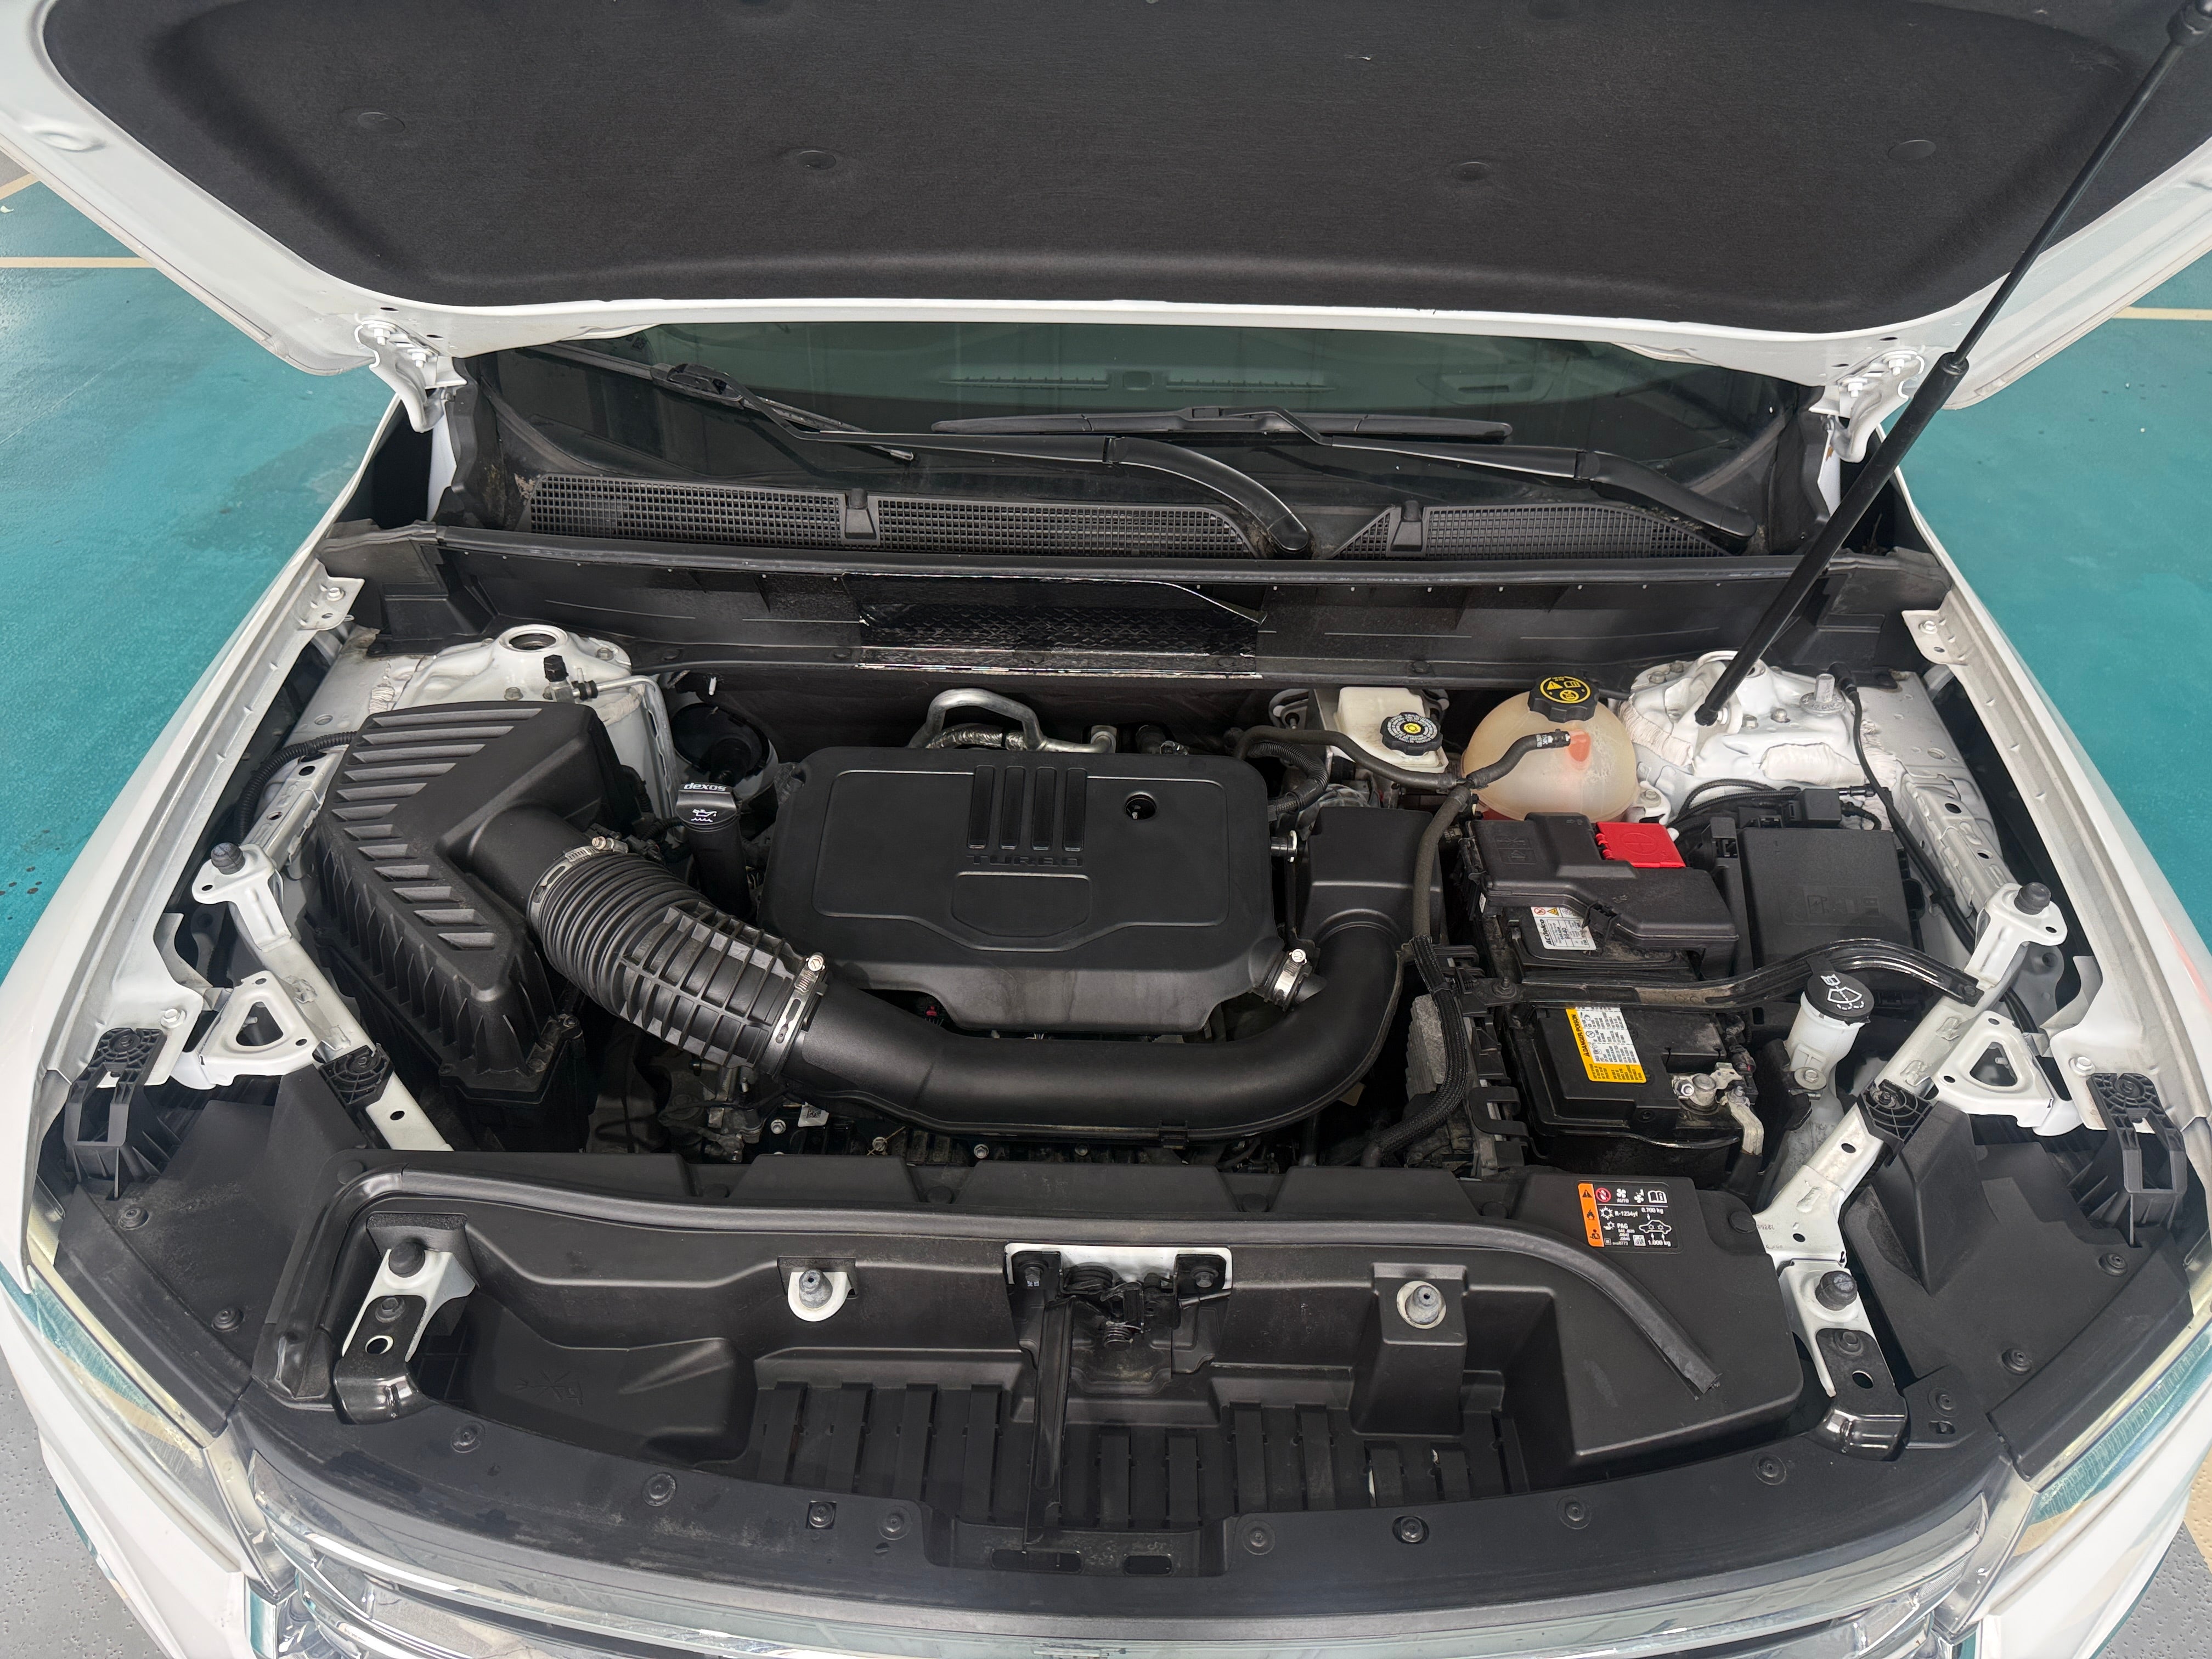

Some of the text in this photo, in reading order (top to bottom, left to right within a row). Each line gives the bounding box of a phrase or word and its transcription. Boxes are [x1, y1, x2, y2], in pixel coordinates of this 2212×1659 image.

[684, 782, 727, 791] dexos
[966, 855, 1083, 868] TURBO
[1539, 919, 1553, 945] ACDelco
